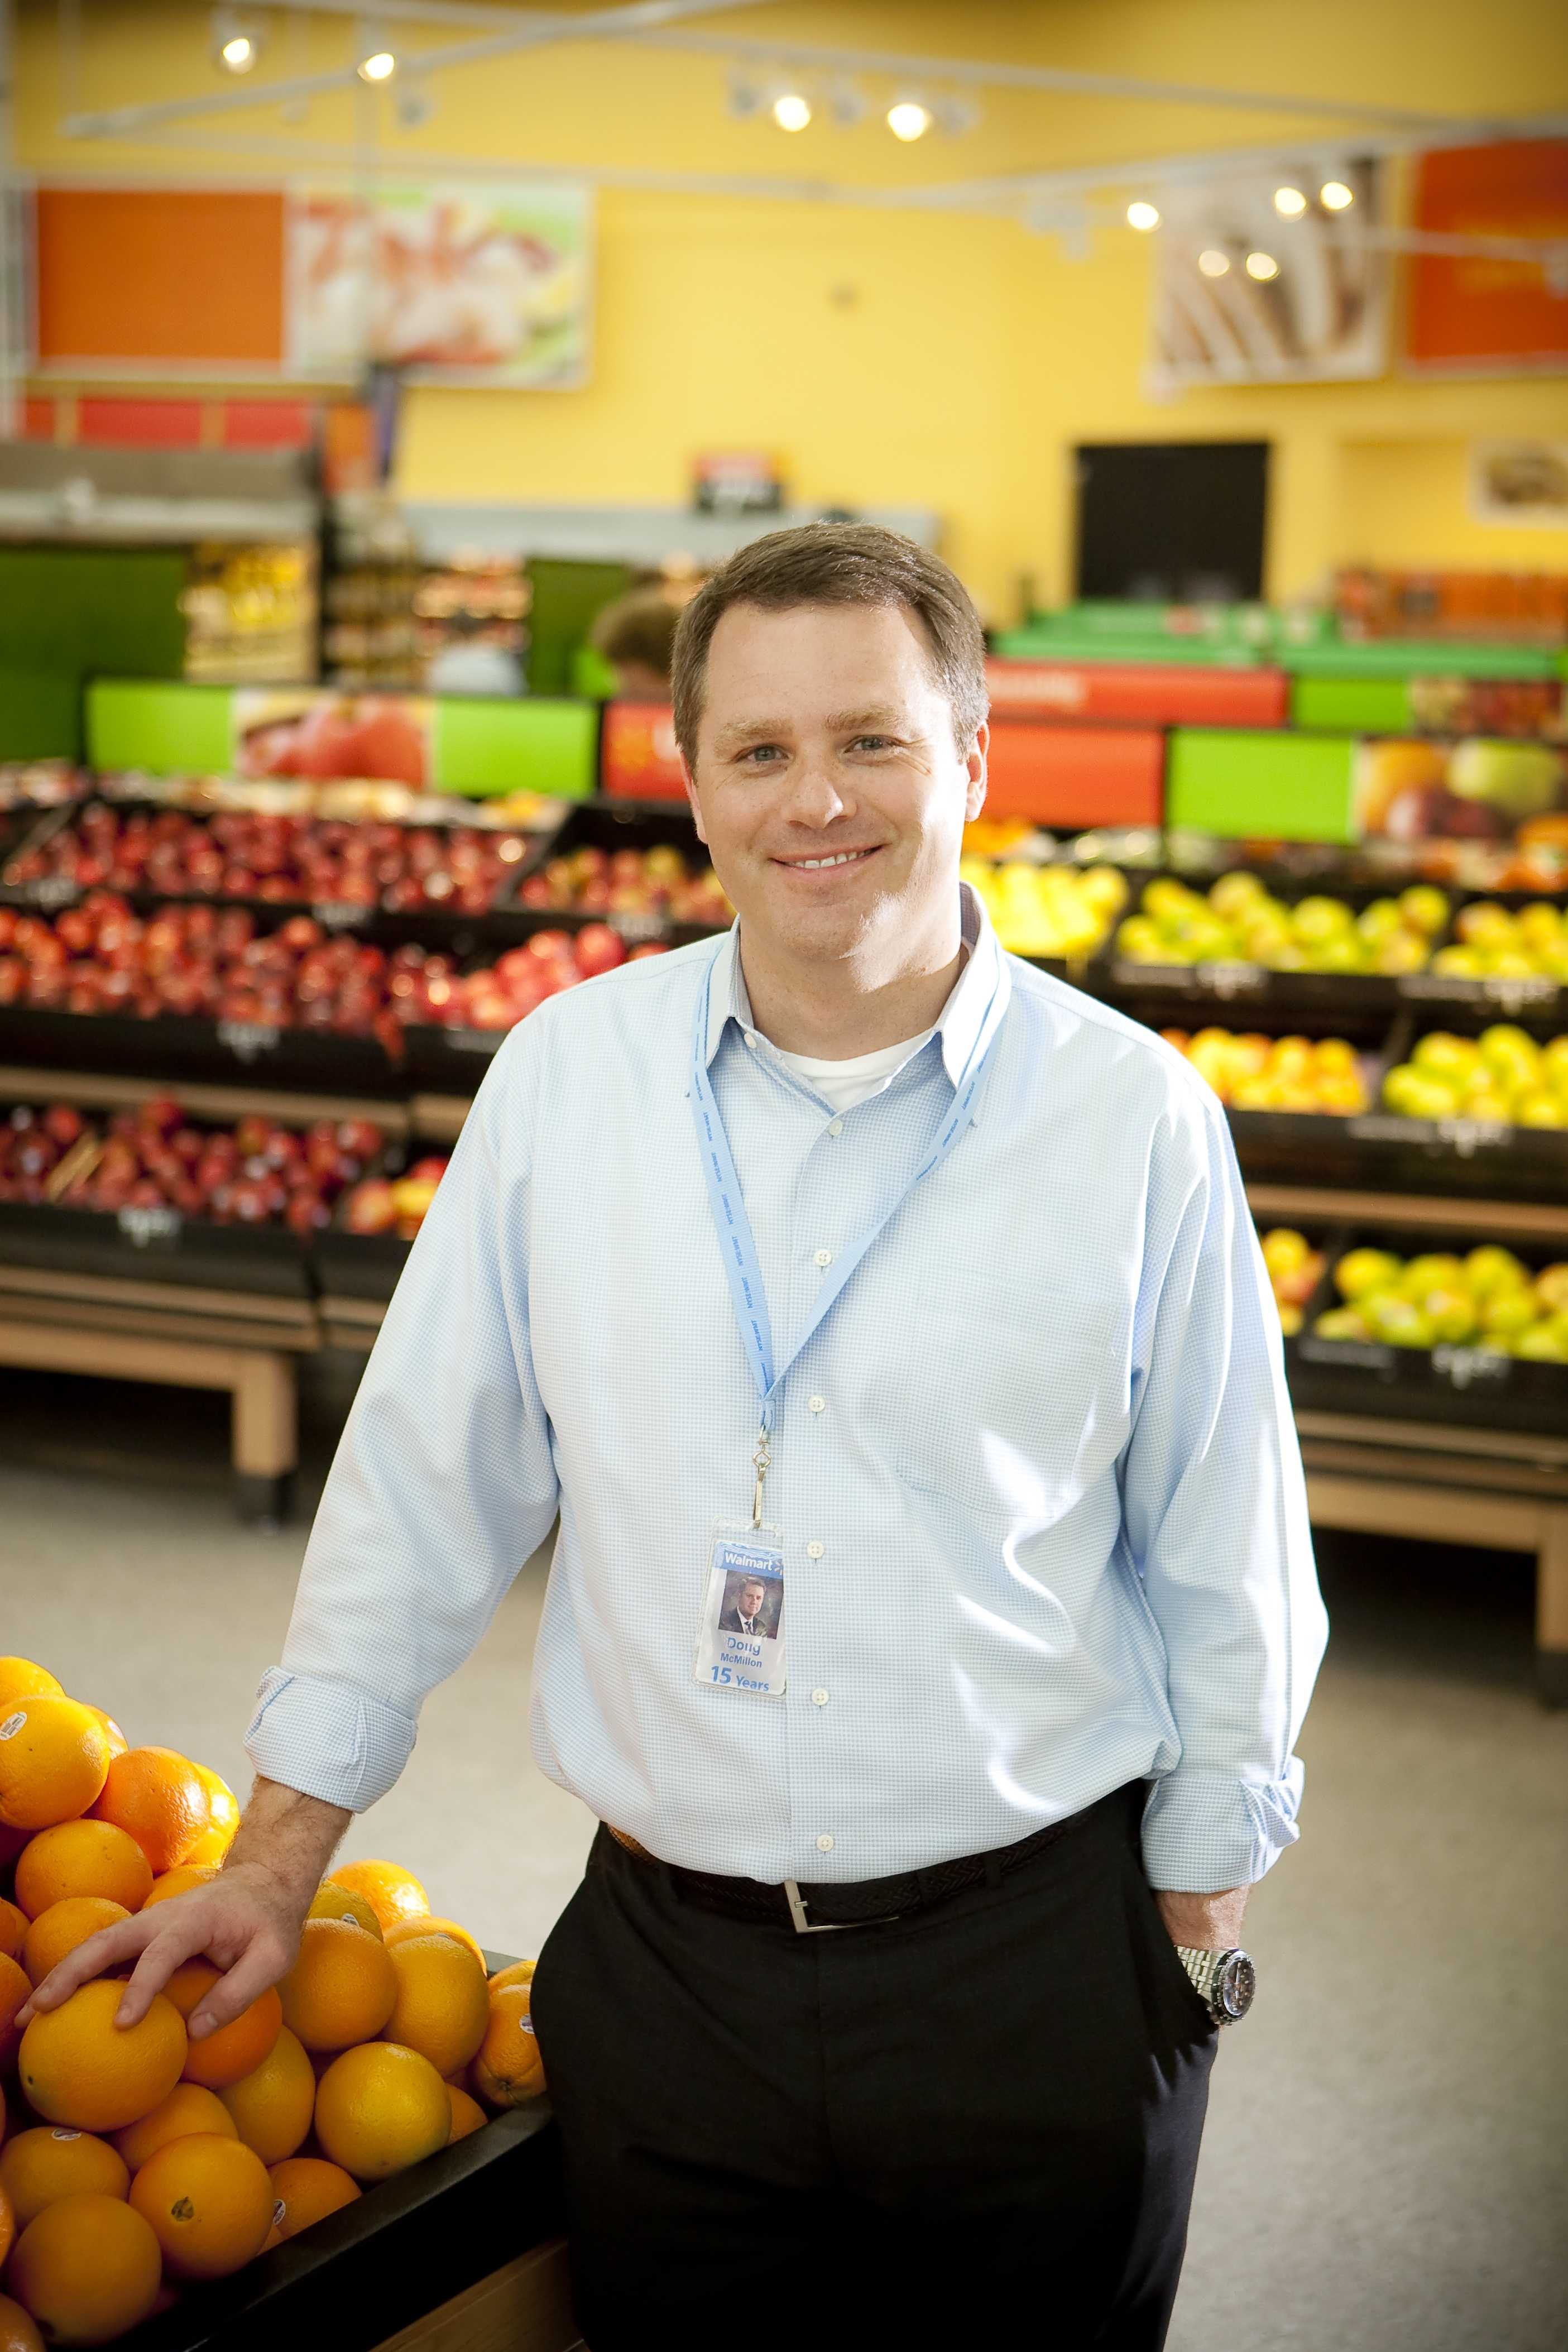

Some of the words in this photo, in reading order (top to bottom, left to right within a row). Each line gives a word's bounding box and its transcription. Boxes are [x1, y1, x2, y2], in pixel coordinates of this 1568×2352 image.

[725, 1552, 773, 1571] Walmart
[720, 1652, 763, 1668] McMillon
[711, 1665, 732, 1684] 15
[736, 1675, 770, 1692] Years
